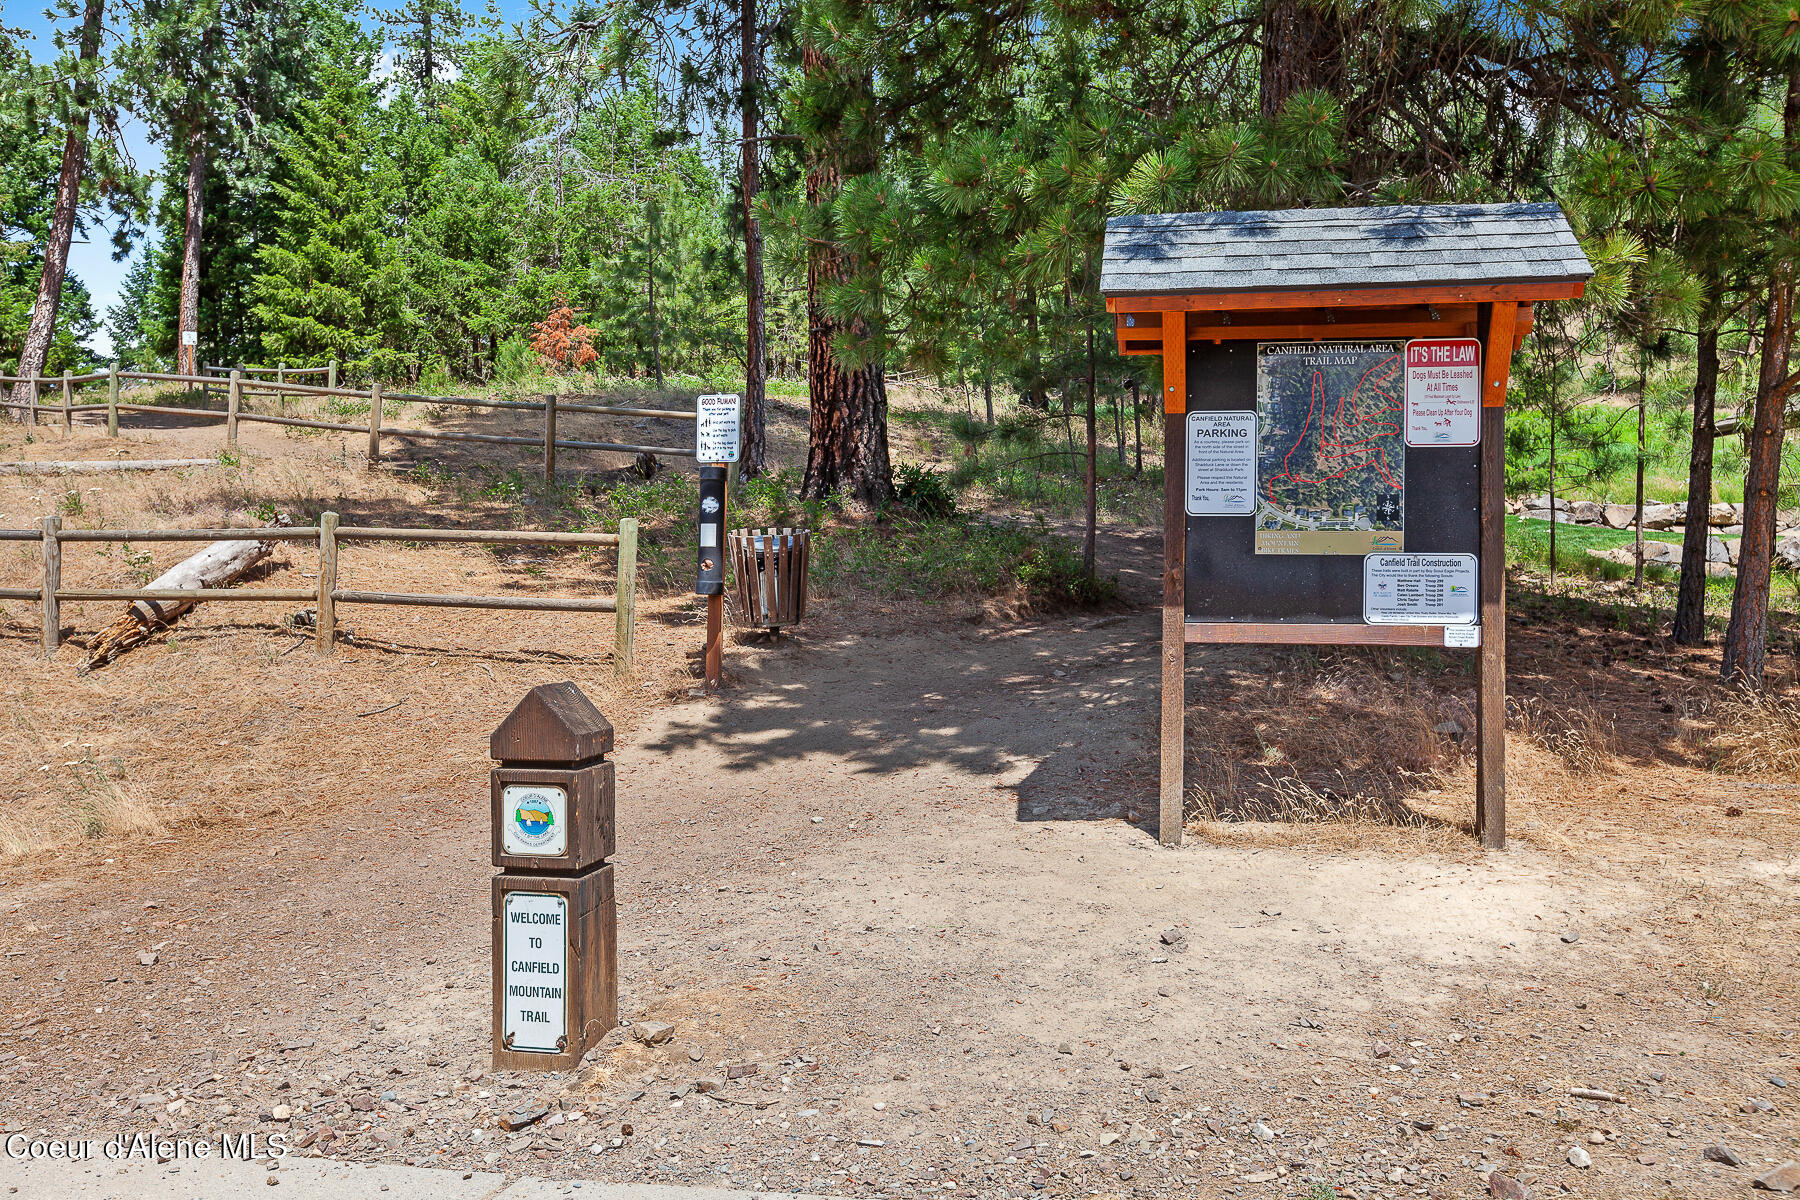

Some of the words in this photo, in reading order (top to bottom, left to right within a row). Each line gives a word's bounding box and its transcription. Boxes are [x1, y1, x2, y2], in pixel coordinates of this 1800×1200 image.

[1267, 345, 1316, 354] CANFIELD
[1319, 345, 1366, 354] NATURAL
[1368, 345, 1394, 354] AREA
[1410, 346, 1428, 362] IT'S
[1430, 346, 1450, 362] THE
[1453, 345, 1476, 362] LAW
[1304, 357, 1332, 365] TRAIL
[1334, 357, 1358, 365] MAP
[1412, 370, 1426, 381] Dogs
[1428, 370, 1440, 379] Must
[1442, 370, 1449, 378] Be
[1450, 370, 1472, 378] Leashed
[1427, 382, 1432, 391] At
[1442, 382, 1458, 391] Times
[1438, 409, 1444, 417] Up
[1464, 408, 1472, 417] Dog
[1197, 429, 1248, 437] PARKING
[511, 912, 561, 925] WELCOME
[529, 938, 542, 949] TO
[512, 960, 560, 974] CANFIELD
[510, 985, 562, 999] MOUNTAIN
[521, 1010, 550, 1023] TRAIL
